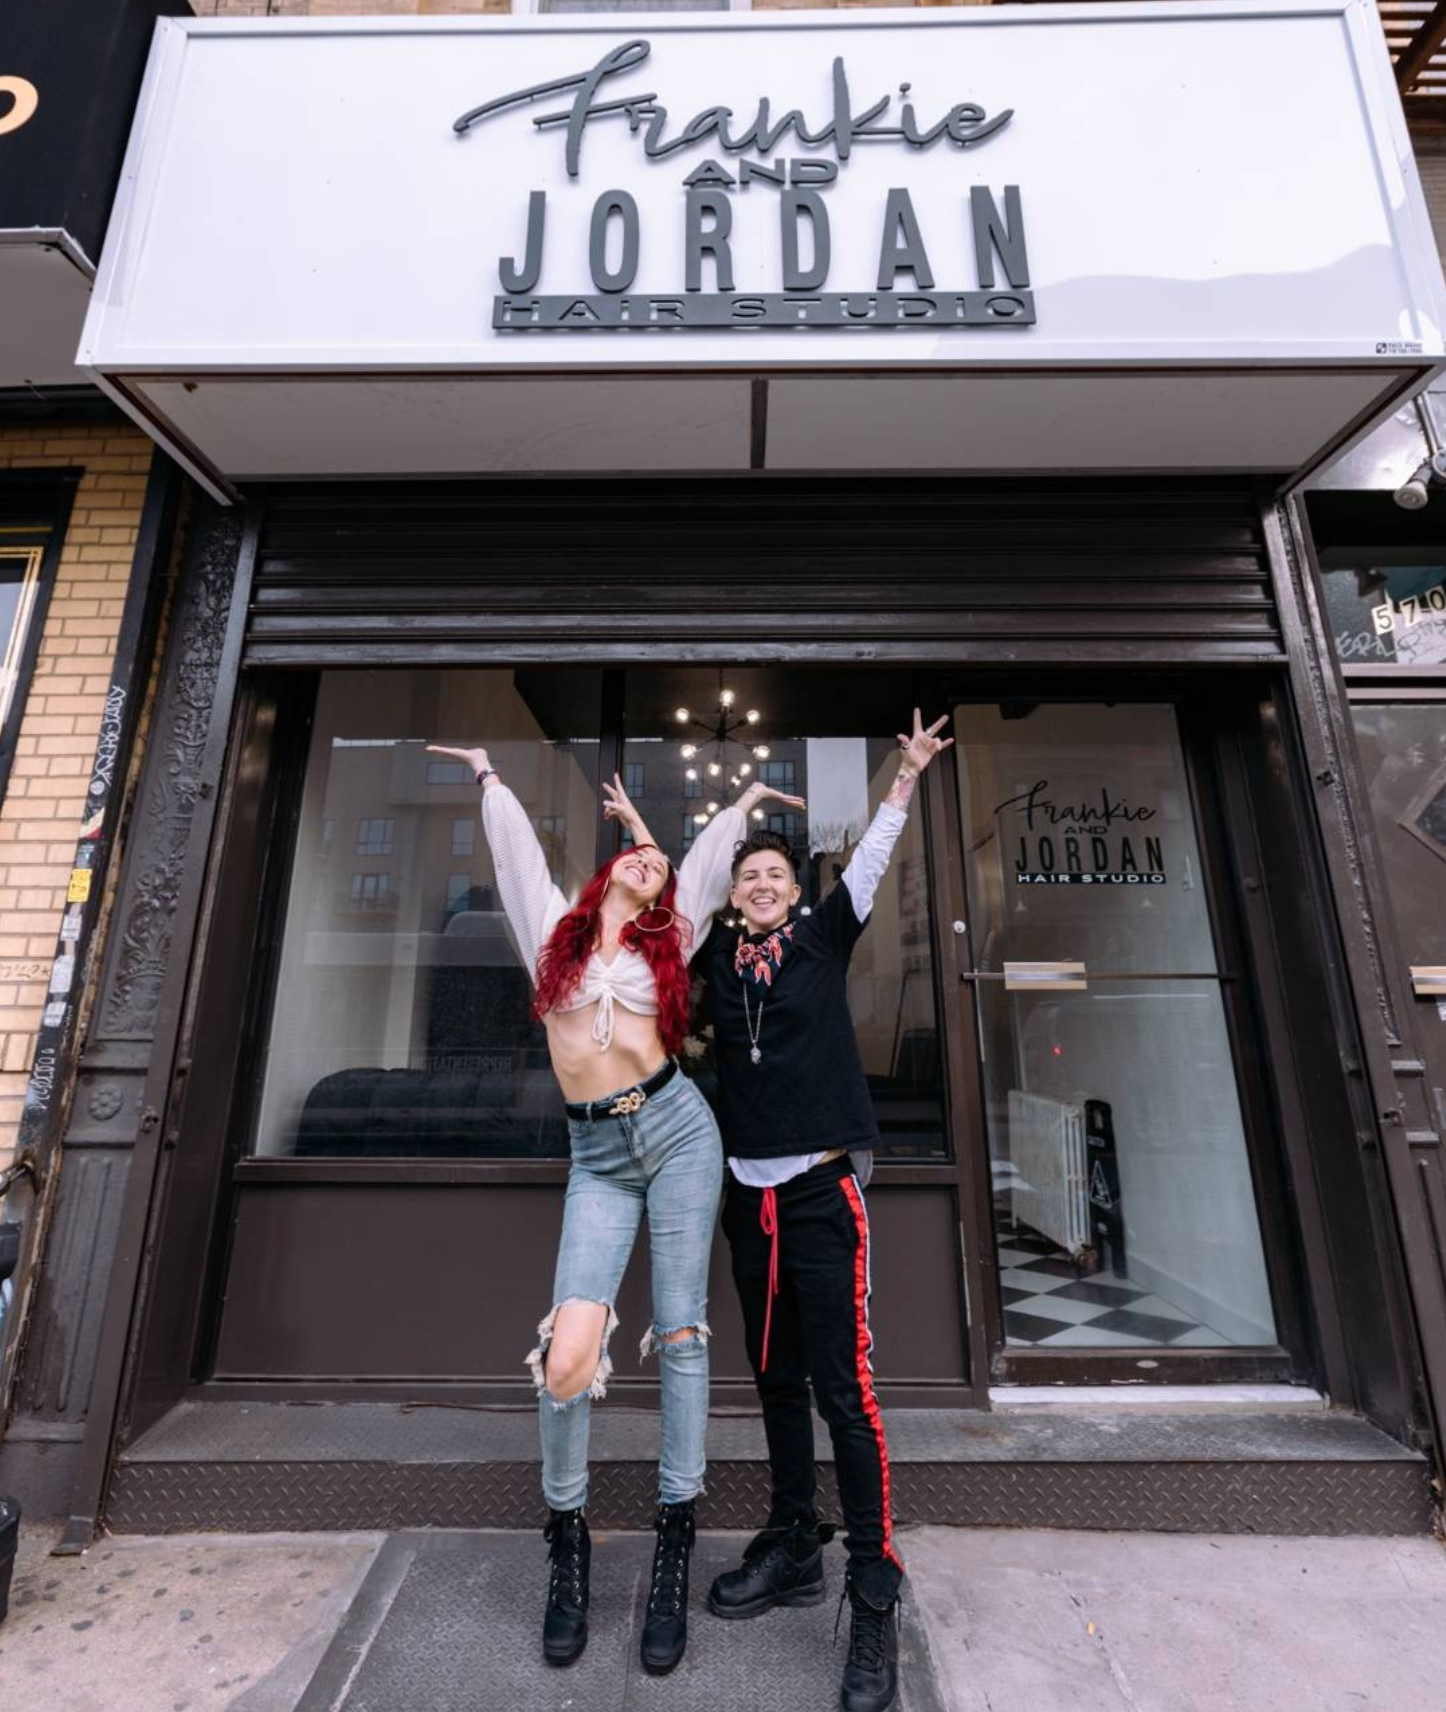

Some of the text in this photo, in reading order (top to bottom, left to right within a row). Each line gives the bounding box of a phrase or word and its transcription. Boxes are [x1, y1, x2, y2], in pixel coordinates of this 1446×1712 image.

[453, 38, 1015, 178] Frankie
[682, 158, 838, 187] AND
[499, 184, 1031, 293] JORDAN
[1375, 589, 1446, 630] 570
[993, 779, 1157, 831] Frankie
[1063, 826, 1108, 835] AND
[1015, 836, 1165, 872] JORDAN
[1017, 874, 1166, 884] HAIR STUDIO
